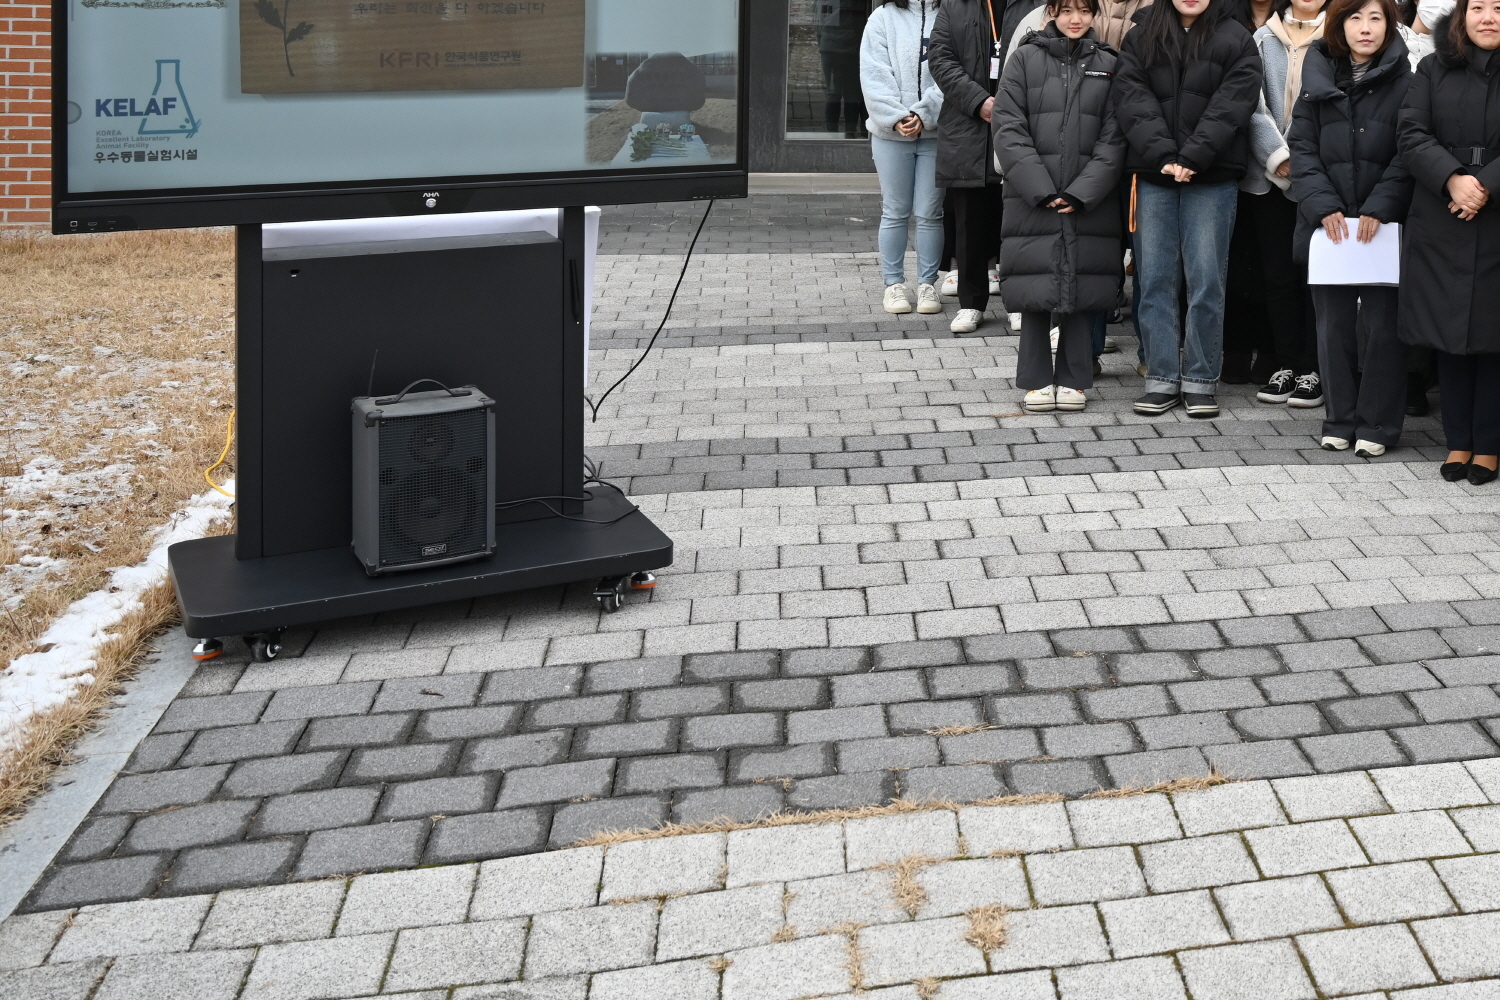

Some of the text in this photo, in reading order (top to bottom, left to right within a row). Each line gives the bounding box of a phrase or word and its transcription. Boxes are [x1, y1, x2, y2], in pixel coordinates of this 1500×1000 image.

[354, 2, 397, 15] 우리는
[477, 2, 546, 15] 하겠습니다
[380, 51, 439, 69] KFRI
[444, 50, 522, 63] 한국식품연구원
[95, 97, 177, 117] KELAF
[131, 135, 171, 143] Laboratory
[94, 149, 198, 164] 우수동물실험시설
